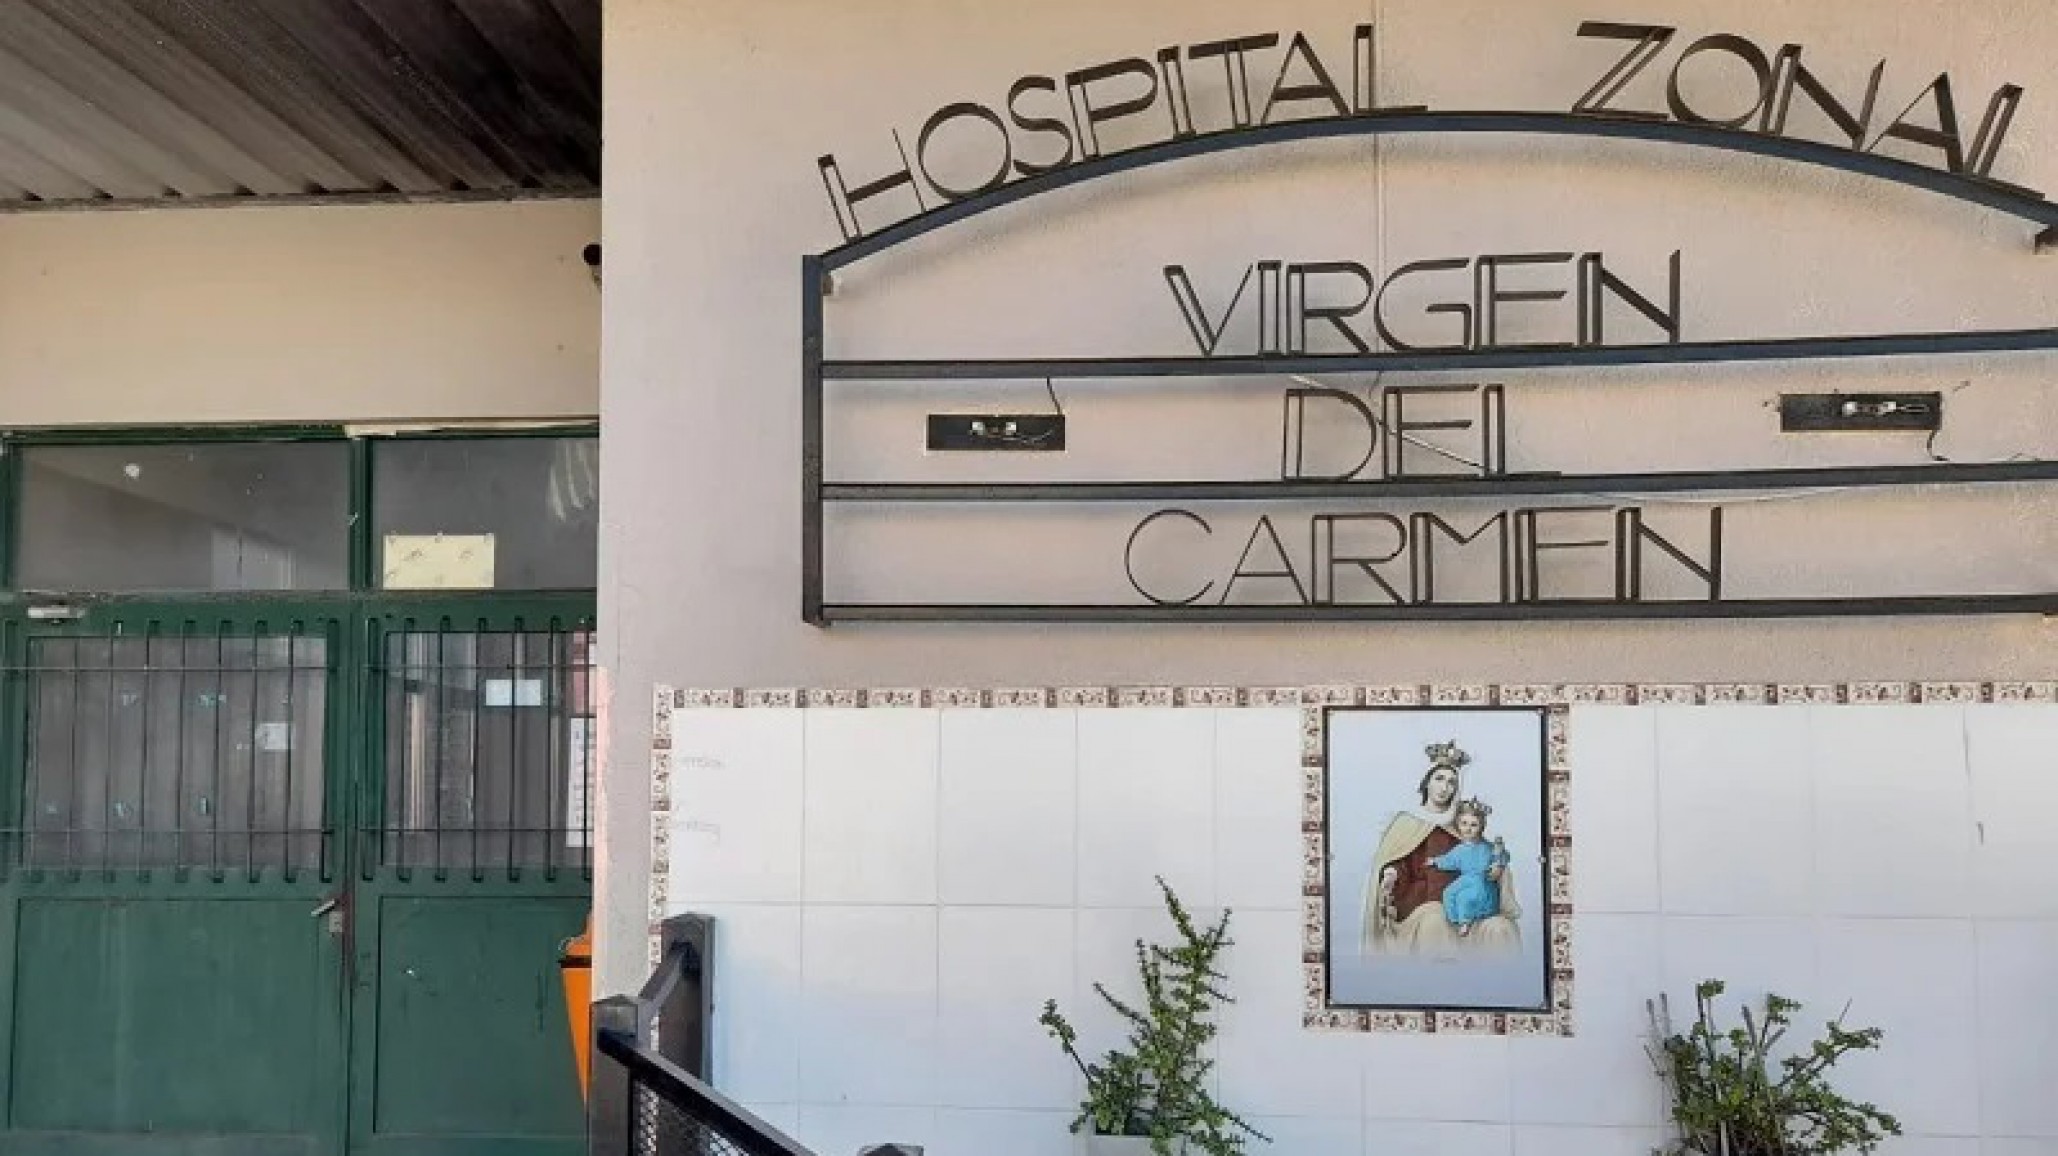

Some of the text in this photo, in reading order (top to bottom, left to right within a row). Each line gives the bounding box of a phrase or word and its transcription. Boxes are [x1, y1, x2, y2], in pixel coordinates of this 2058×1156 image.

[817, 20, 2046, 243] HOSPITAL ZONAL
[1163, 249, 1681, 357] VIRGEN
[1281, 383, 1562, 482] DEL
[1124, 506, 1722, 606] CARMEN
